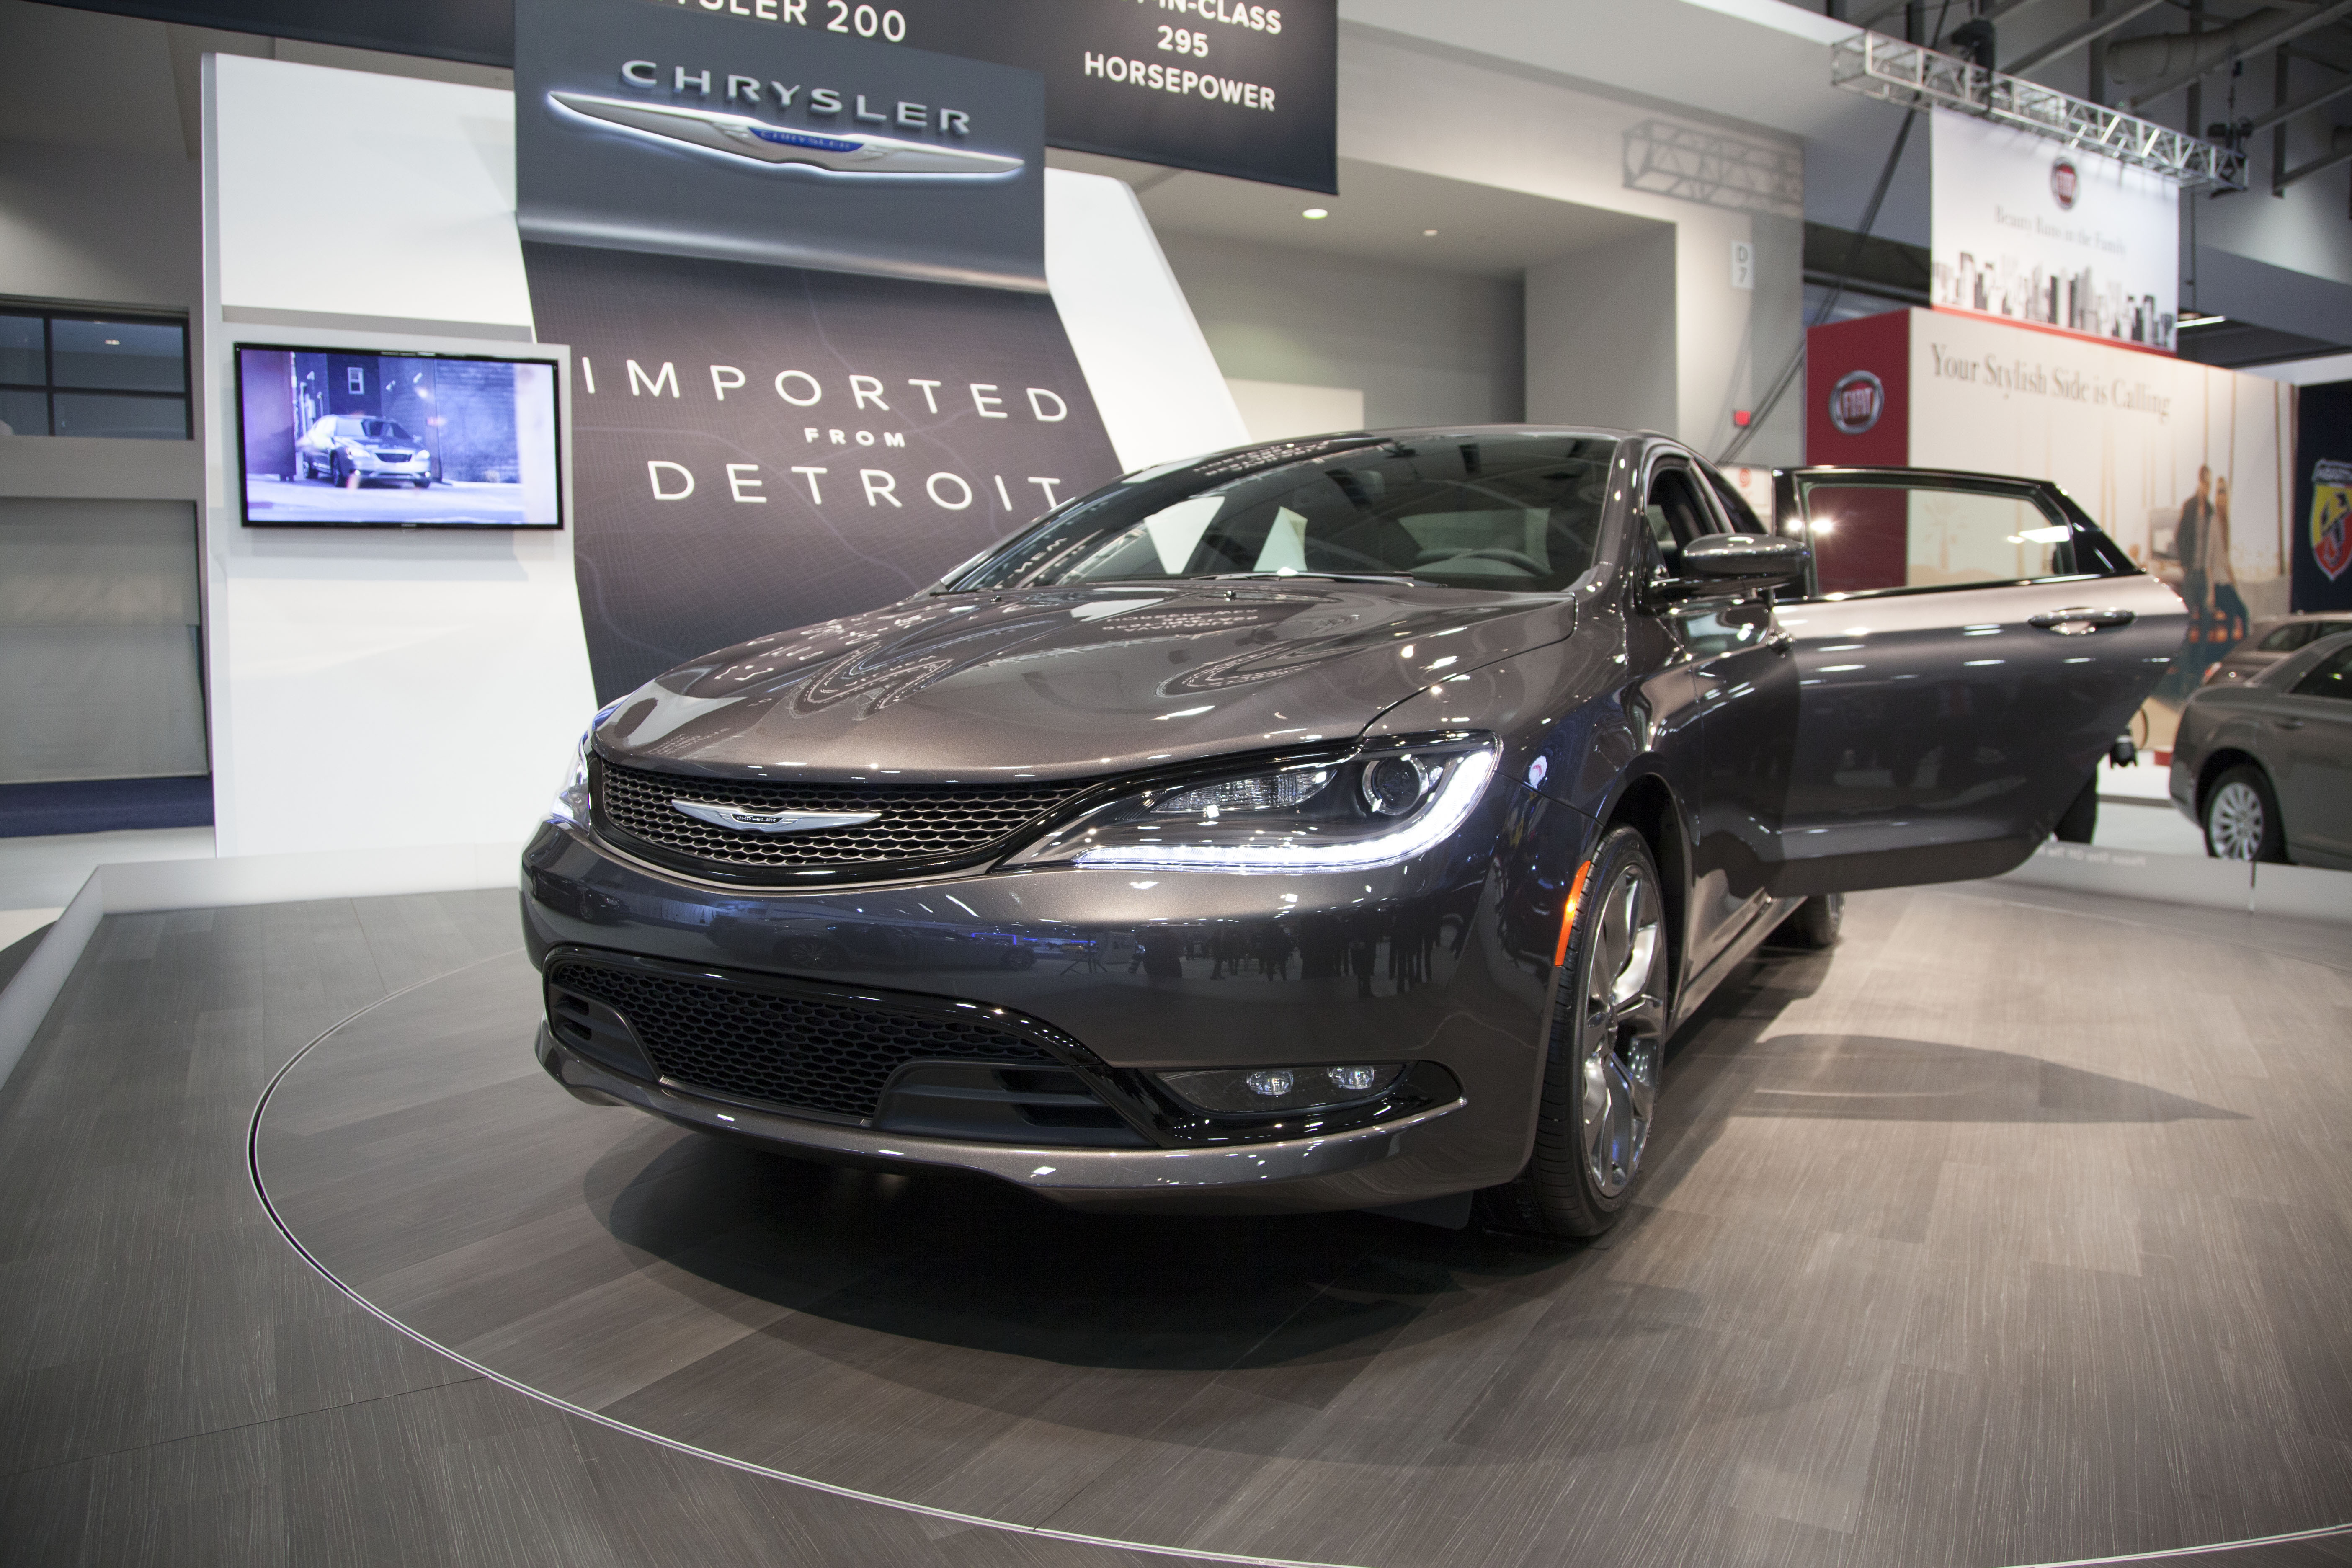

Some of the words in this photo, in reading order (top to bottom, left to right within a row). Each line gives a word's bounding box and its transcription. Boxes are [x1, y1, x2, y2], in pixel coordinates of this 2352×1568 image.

[826, 0, 906, 42] 200
[1157, 25, 1209, 58] 295
[621, 60, 970, 134] CHRYSLER
[1084, 51, 1276, 112] HORSEPOWER
[582, 356, 1068, 422] IMPORTED
[1842, 387, 1873, 419] FIAT
[1930, 342, 1979, 382] Your
[1983, 352, 2047, 400] Stylish
[2052, 366, 2090, 402] Side
[2093, 374, 2109, 406] is
[2112, 378, 2171, 425] Calling
[804, 427, 905, 448] FROM
[647, 460, 1061, 512] DETROIT
